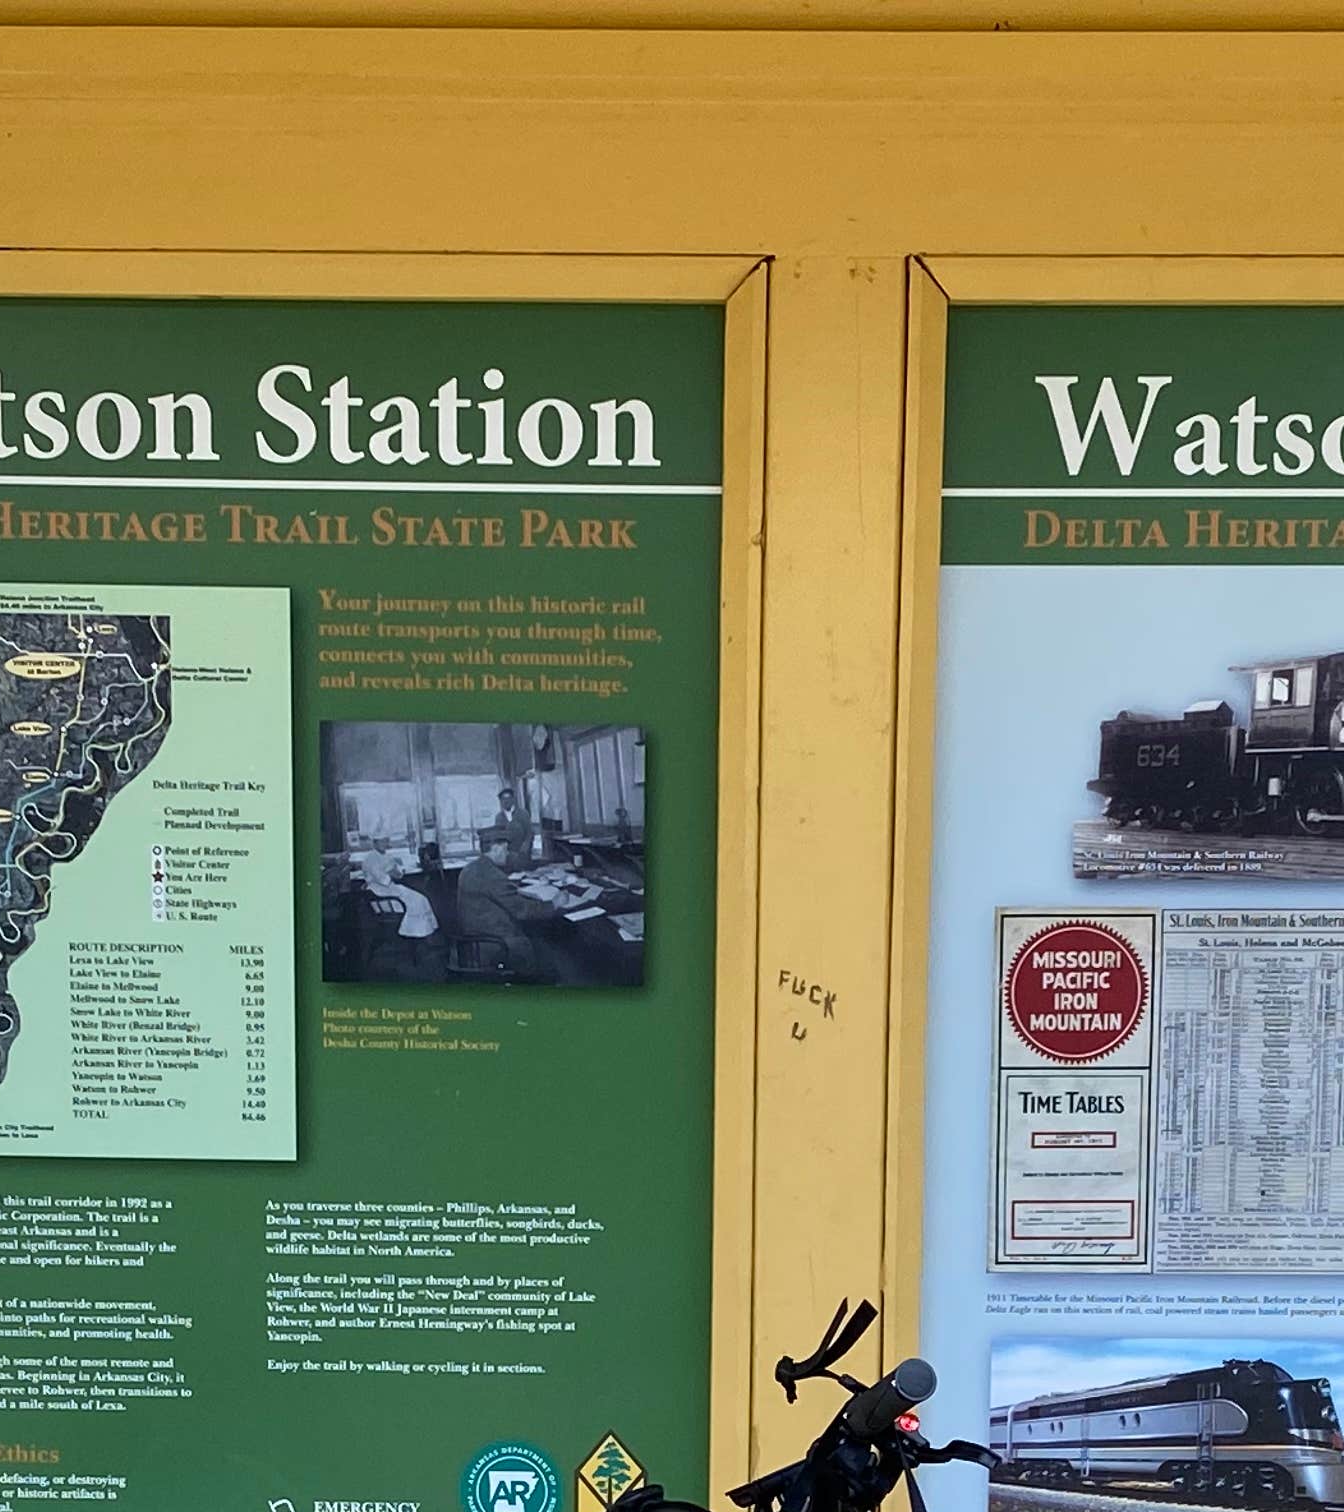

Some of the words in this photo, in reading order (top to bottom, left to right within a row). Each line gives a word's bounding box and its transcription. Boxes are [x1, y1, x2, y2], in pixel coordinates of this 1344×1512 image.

[256, 364, 661, 467] Station
[220, 503, 356, 546] TRAIL
[372, 507, 504, 549] STATE
[522, 510, 634, 550] PARK
[1025, 510, 1167, 549] DELTA
[319, 589, 371, 613] Your
[373, 594, 450, 617] journey
[457, 599, 482, 614] on
[488, 595, 524, 614] this
[530, 596, 606, 615] historic
[612, 597, 645, 615] rail
[318, 624, 370, 638] route
[377, 624, 479, 642] transports
[486, 627, 521, 645] you
[528, 624, 607, 645] through
[613, 625, 662, 644] time,
[319, 650, 405, 665] connects
[411, 651, 446, 670] you
[451, 648, 494, 665] with
[500, 650, 633, 669] communities,
[319, 673, 356, 689] and
[361, 675, 432, 690] reveals
[436, 674, 475, 690] rich
[482, 674, 534, 692] Delta
[539, 676, 628, 697] heritage.
[153, 780, 177, 790] Delta
[180, 781, 220, 792] Heritage
[224, 781, 245, 790] Trail
[248, 781, 265, 792] Key
[70, 943, 106, 952] ROUTE
[110, 943, 183, 952] DESCRIPTION
[230, 946, 263, 954] MILES
[1033, 951, 1120, 968] MISSOURI
[1043, 972, 1110, 989] PACIFIC
[778, 970, 837, 1020] FUCK
[1055, 993, 1097, 1010] IRON
[1031, 1014, 1123, 1032] MOUNTAIN
[4, 1195, 25, 1206] this
[28, 1195, 51, 1207] trail
[55, 1196, 102, 1207] corridor
[106, 1197, 117, 1208] in
[122, 1198, 147, 1208] 1992
[268, 1360, 299, 1373] Enjoy
[303, 1360, 320, 1370] the
[324, 1360, 346, 1370] trail
[350, 1360, 363, 1374] by
[367, 1361, 410, 1374] walking
[428, 1361, 469, 1376] cycling
[472, 1363, 480, 1372] it
[484, 1363, 494, 1373] in
[498, 1363, 545, 1373] sections.
[501, 1446, 551, 1473] DEPARTMENT
[0, 1473, 49, 1487] defacing,
[53, 1476, 65, 1485] or
[68, 1474, 126, 1488] destroying
[18, 1487, 58, 1499] historic
[61, 1488, 105, 1499] artifacts
[108, 1489, 116, 1499] is
[492, 1480, 530, 1506] AR
